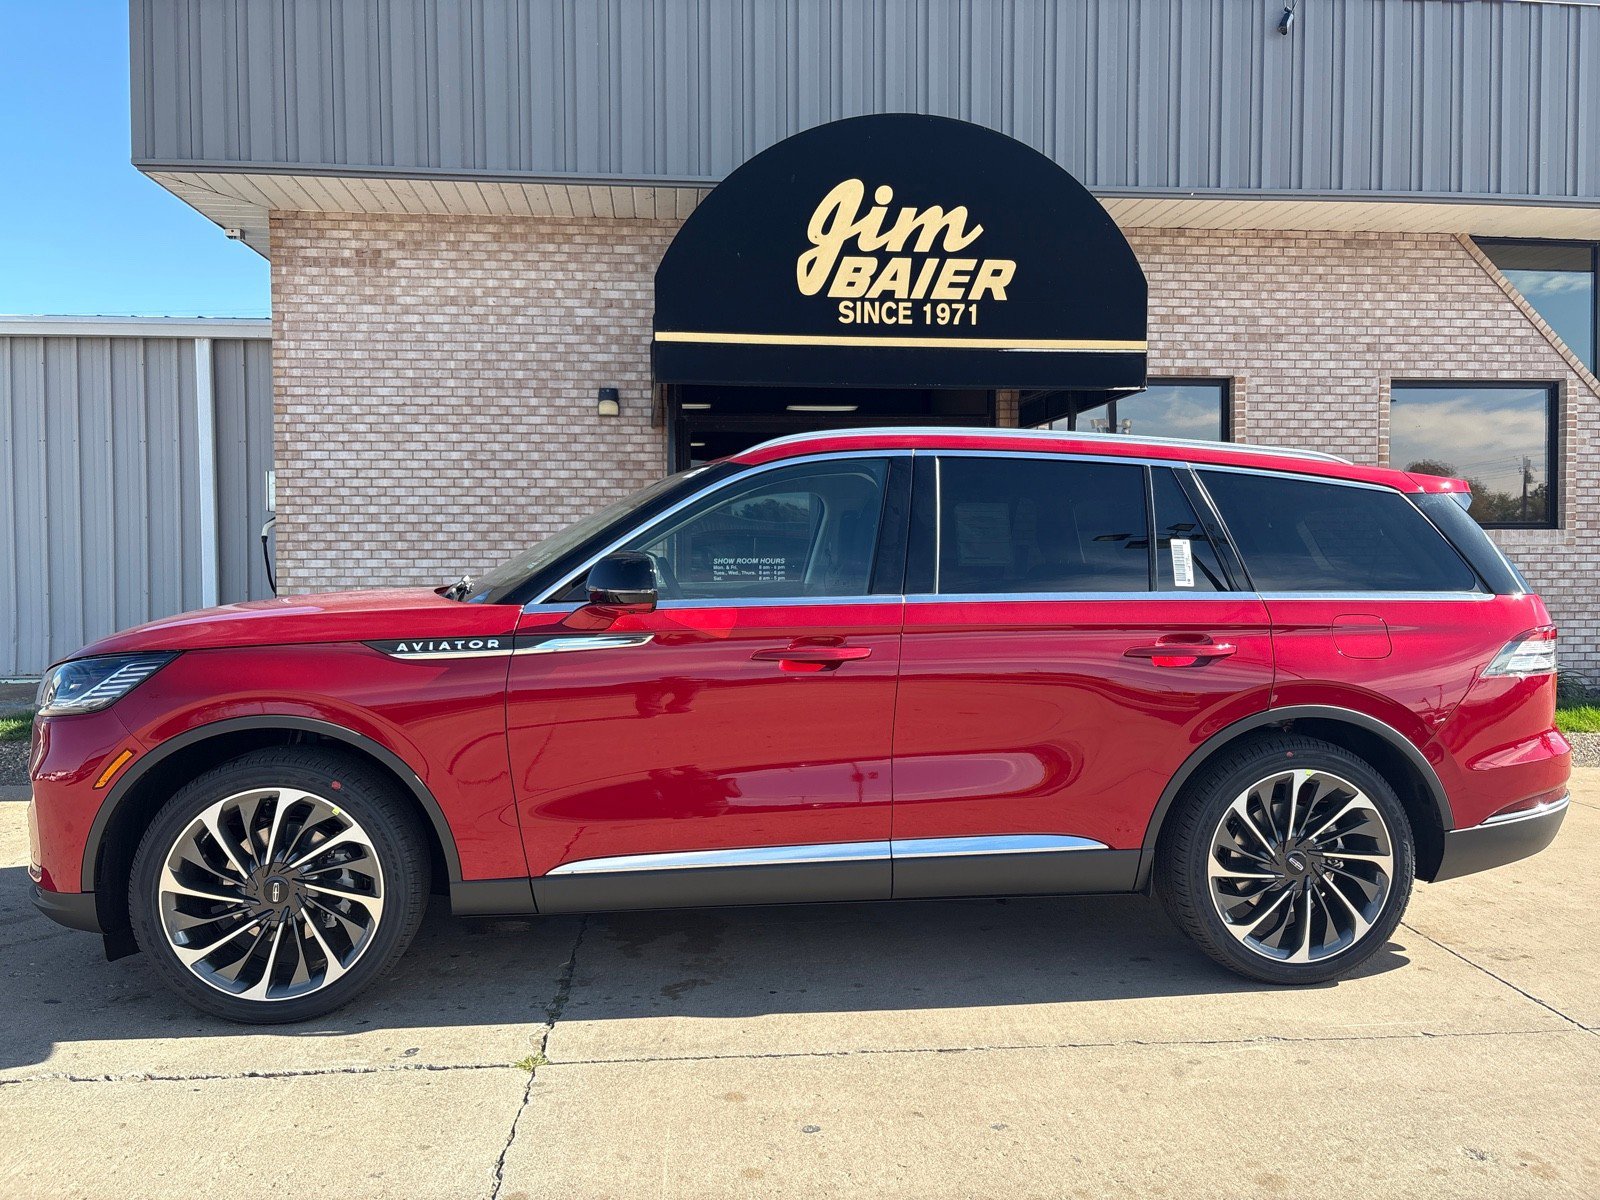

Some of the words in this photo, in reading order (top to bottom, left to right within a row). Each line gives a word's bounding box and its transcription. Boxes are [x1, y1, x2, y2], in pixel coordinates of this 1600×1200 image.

[797, 178, 984, 296] Jim
[827, 256, 1017, 301] BAIER
[838, 300, 913, 324] SINCE
[922, 302, 977, 325] 1971
[396, 639, 500, 652] AVIATOR
